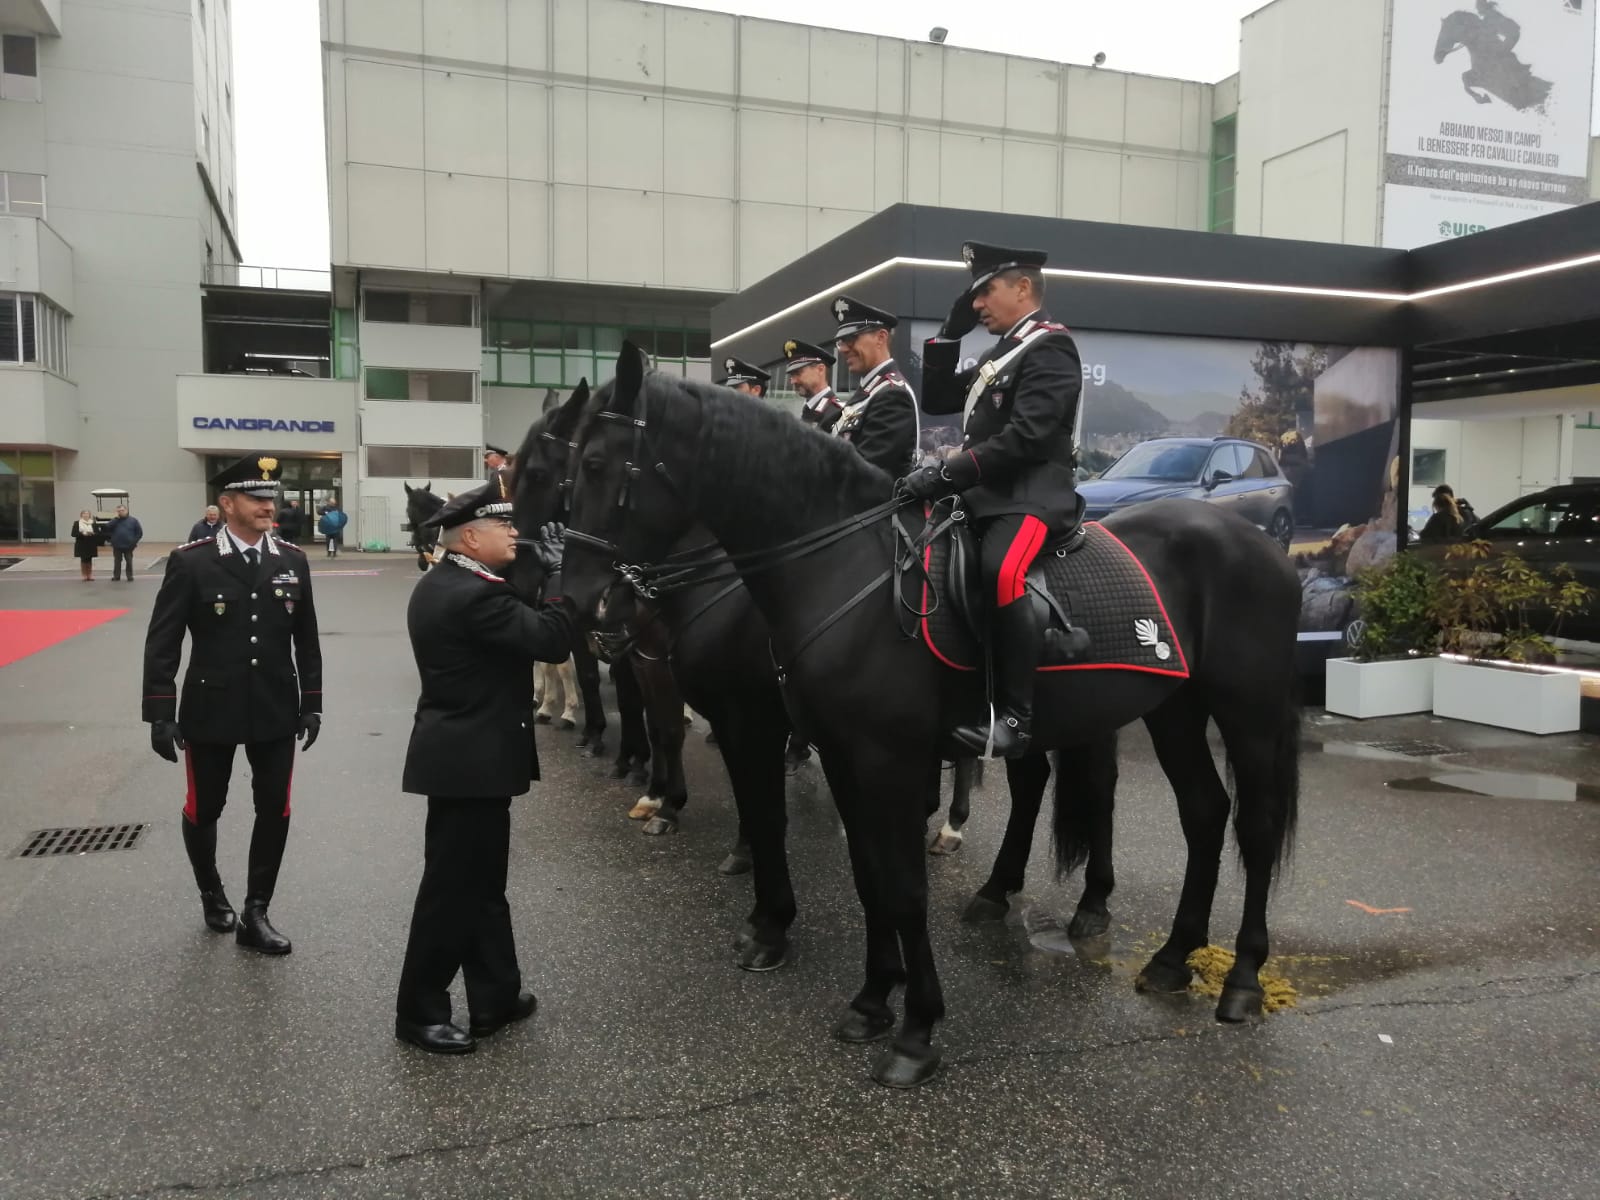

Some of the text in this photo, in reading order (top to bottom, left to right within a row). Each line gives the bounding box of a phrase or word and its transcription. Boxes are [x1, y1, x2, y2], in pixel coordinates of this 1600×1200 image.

[1440, 121, 1541, 149] ABBIAMO MESSO IN CAMPO
[1418, 136, 1559, 168] IL BENESSERE PER CAVALLI E CAVALIERI
[1415, 165, 1438, 178] futuro
[1439, 168, 1496, 185] dell'equitazione
[193, 416, 335, 433] CANGRANDE
